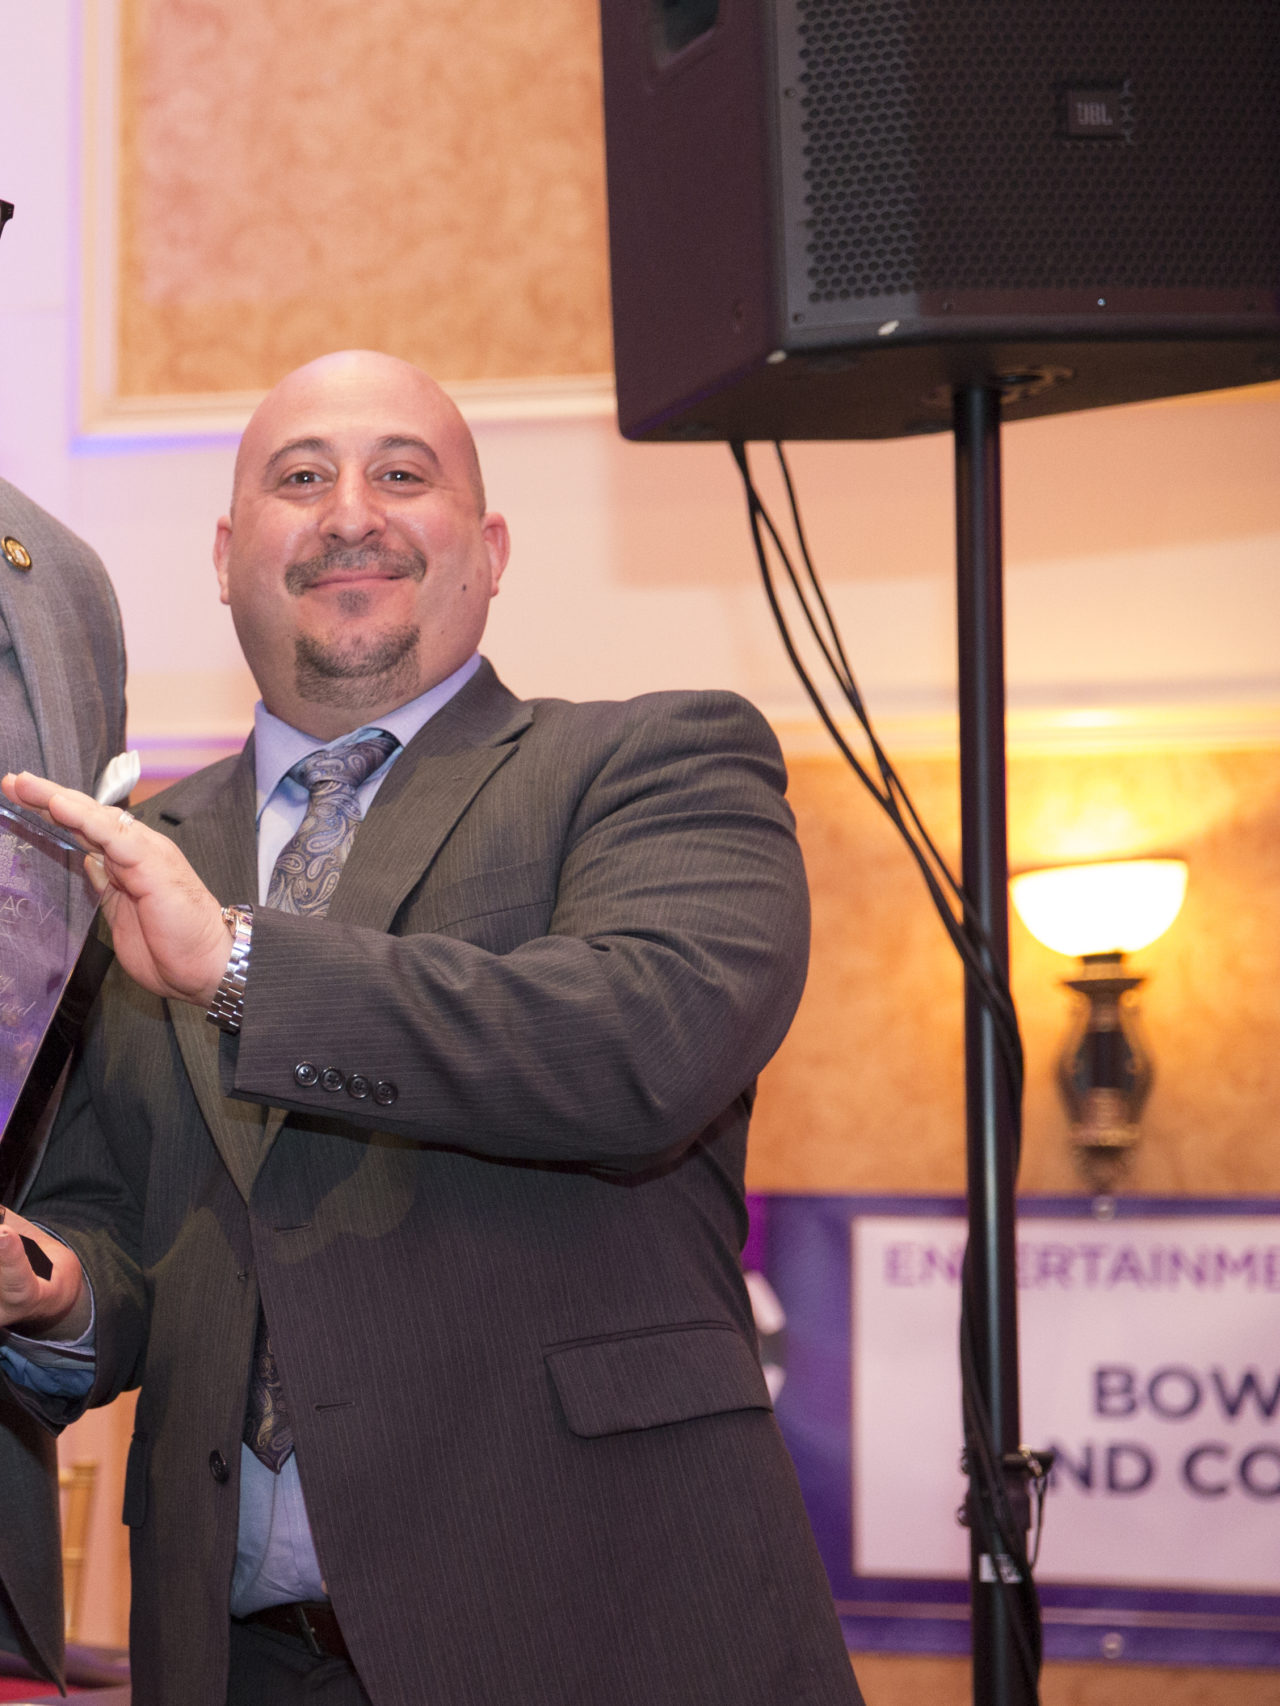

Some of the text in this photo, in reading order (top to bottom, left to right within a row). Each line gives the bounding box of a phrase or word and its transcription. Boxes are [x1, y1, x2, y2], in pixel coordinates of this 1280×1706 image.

[1076, 101, 1113, 126] JBL
[884, 1242, 1280, 1292] ENRTAINME
[1044, 1443, 1154, 1495] ND
